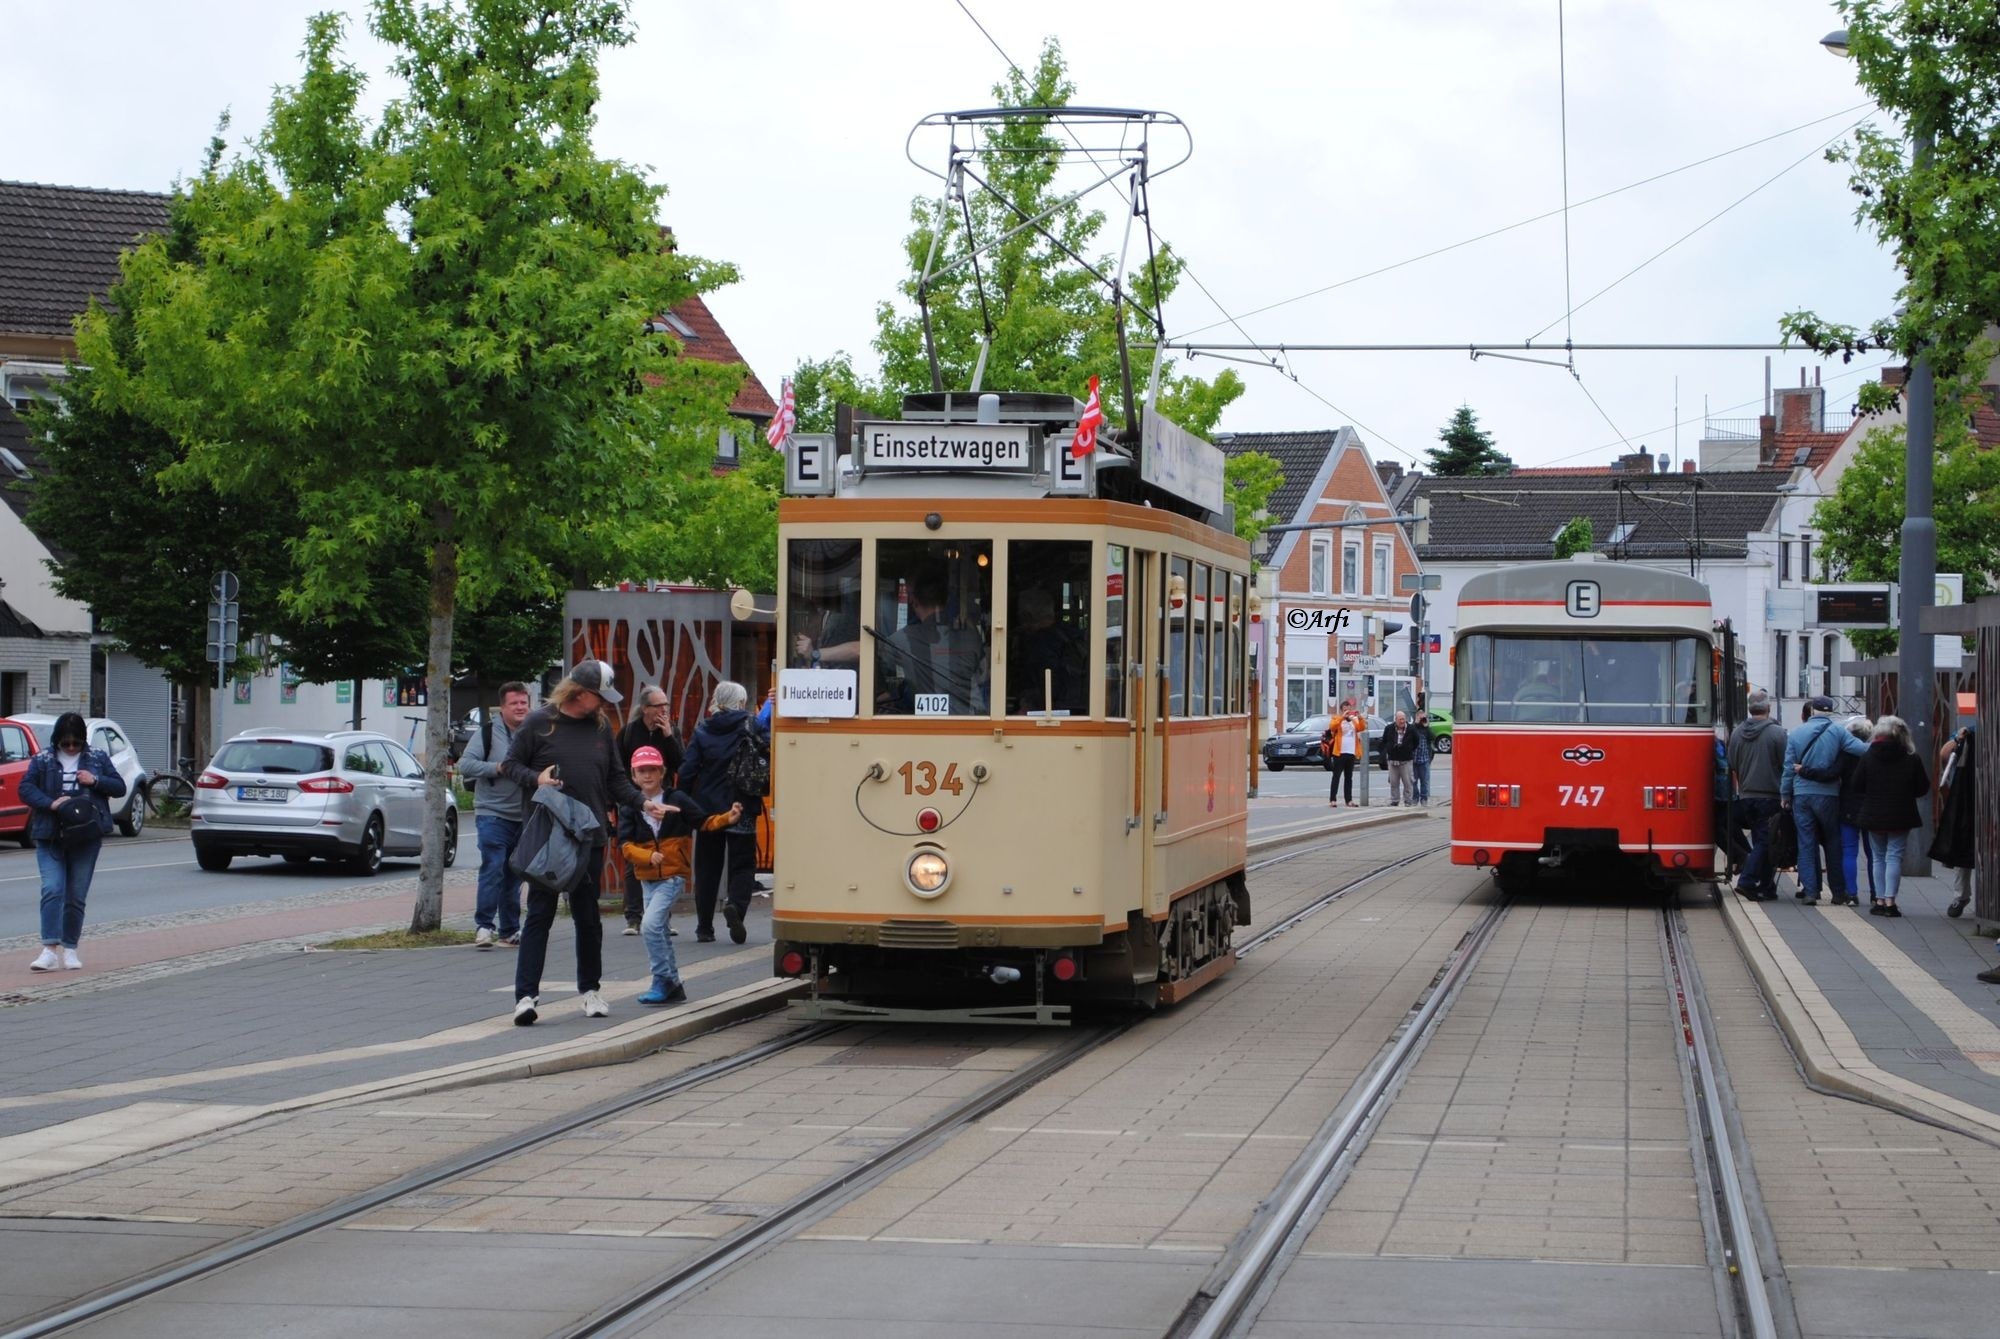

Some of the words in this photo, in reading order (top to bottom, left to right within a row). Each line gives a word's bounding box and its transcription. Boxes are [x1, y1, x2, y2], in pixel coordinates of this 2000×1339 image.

[873, 433, 1020, 465] Einsetzwagen
[798, 445, 819, 481] E
[1061, 446, 1082, 481] E
[1575, 585, 1591, 612] E
[1359, 658, 1374, 666] Halt
[789, 686, 844, 700] Huckelriede
[916, 696, 948, 712] 4102
[897, 760, 964, 796] 134
[1558, 785, 1605, 807] 747
